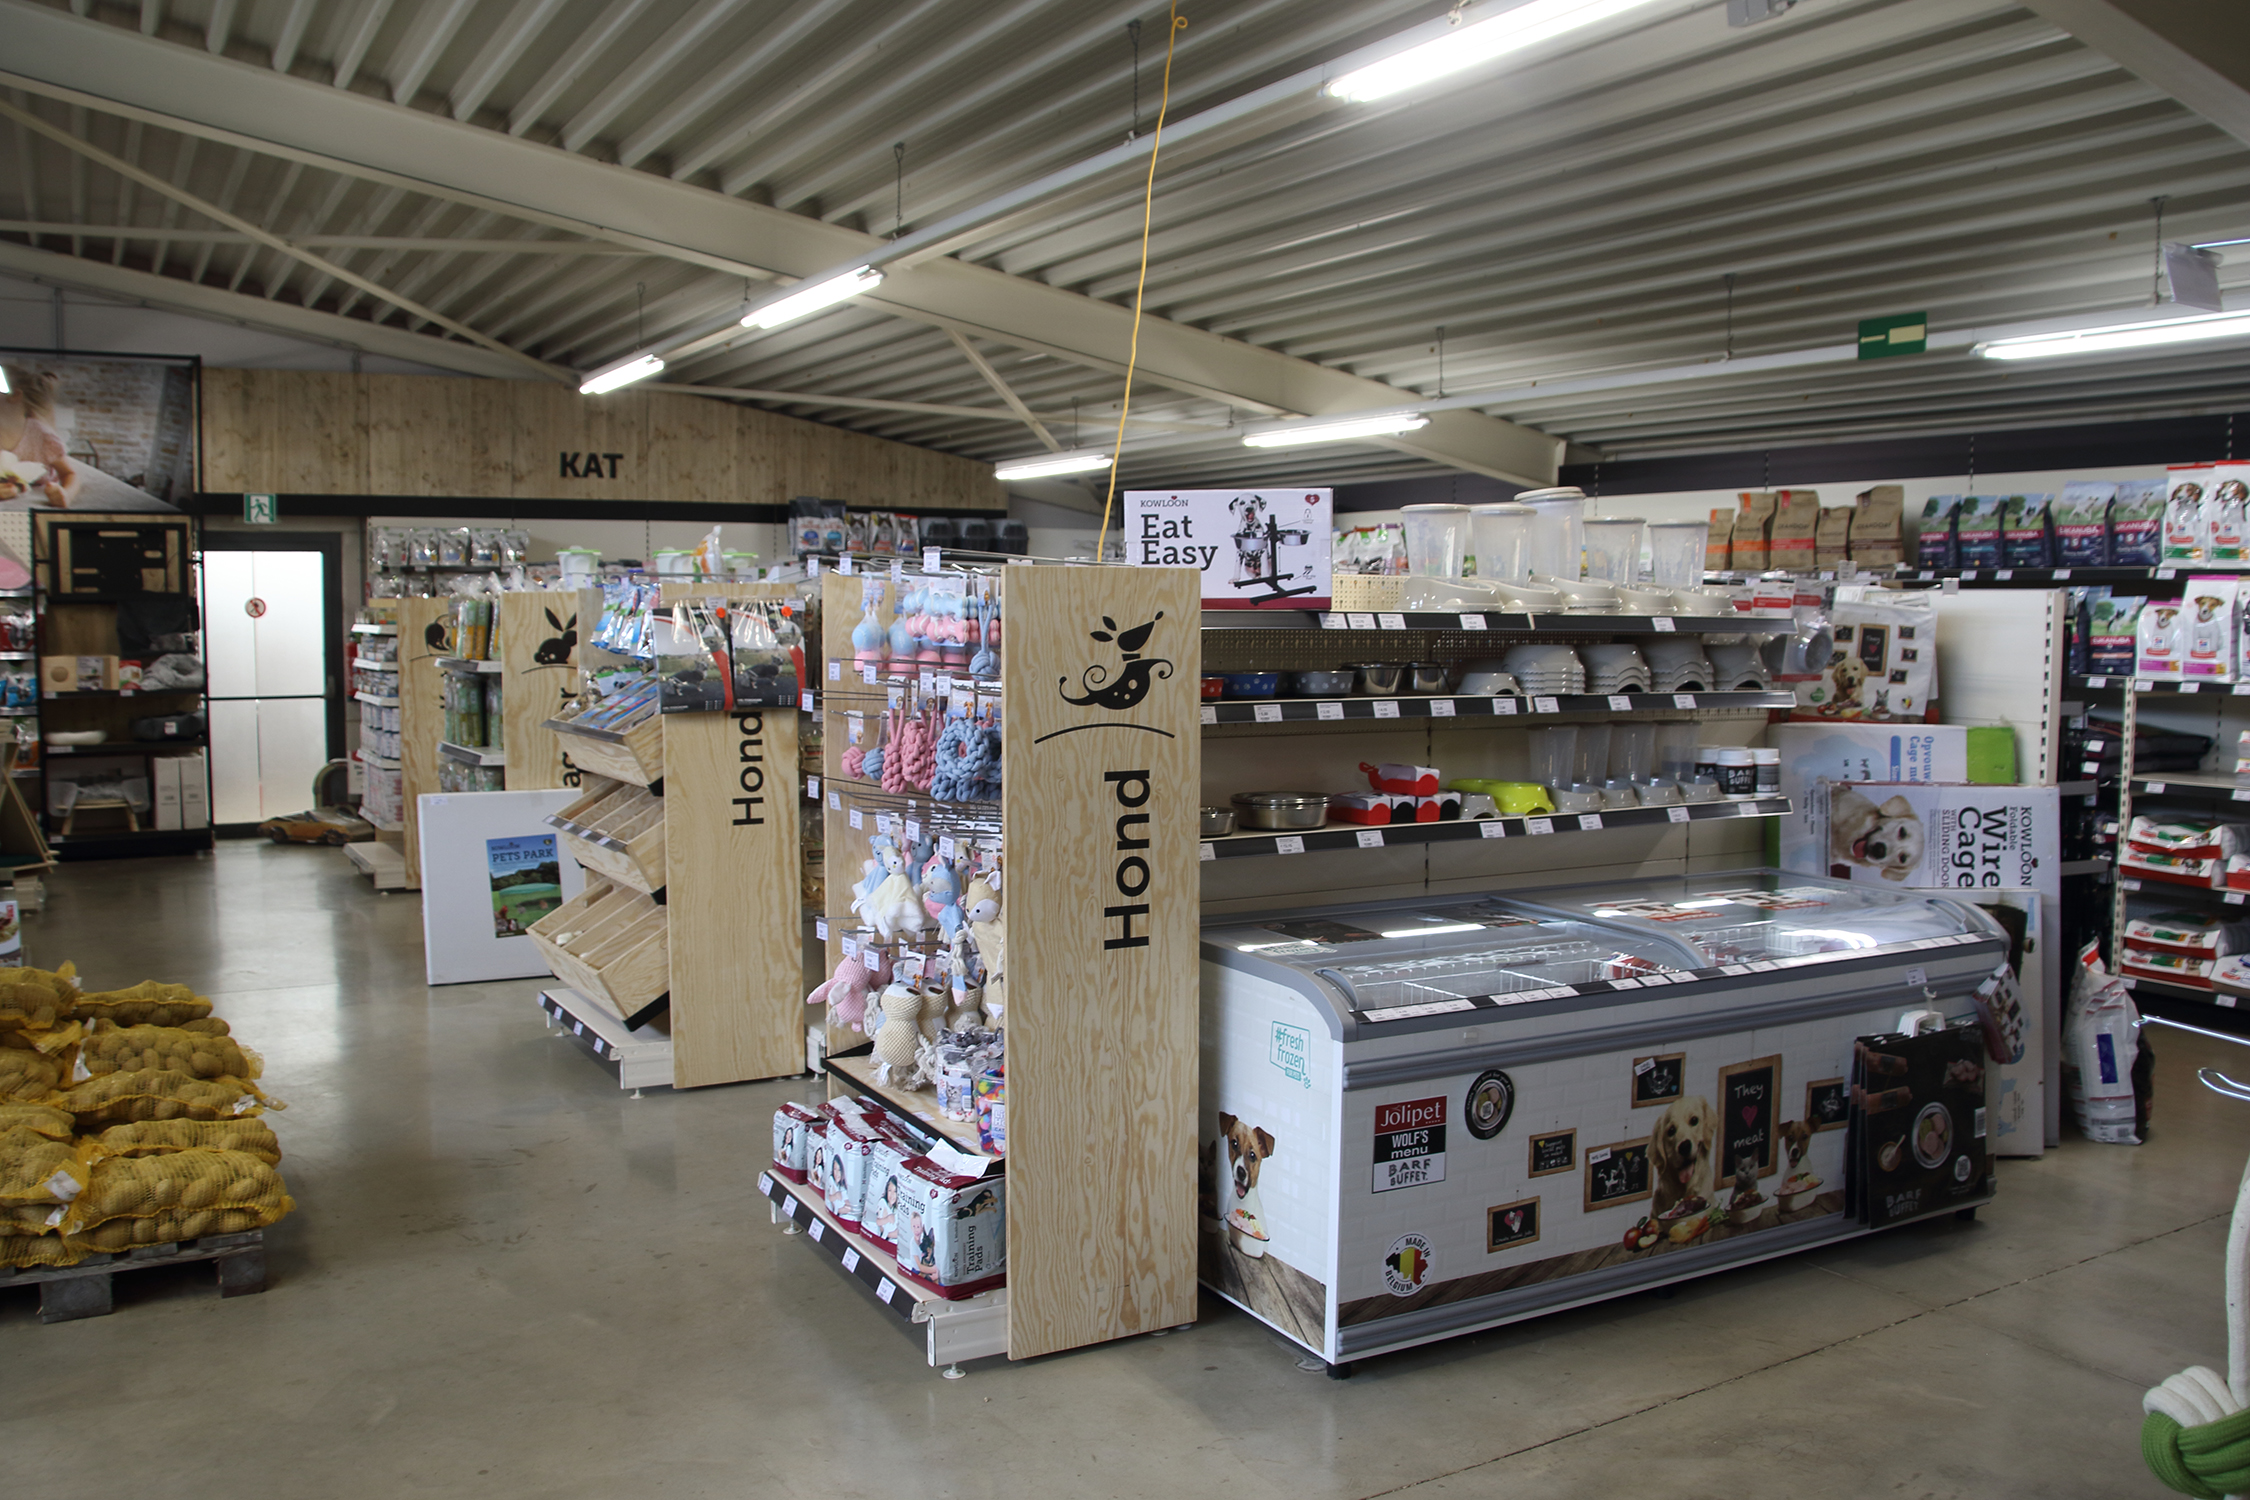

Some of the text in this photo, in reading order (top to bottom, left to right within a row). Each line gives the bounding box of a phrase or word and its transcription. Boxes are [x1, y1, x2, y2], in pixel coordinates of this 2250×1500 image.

[559, 452, 624, 479] KAT
[1140, 498, 1189, 508] KOWLOON
[1141, 513, 1193, 540] Eat
[1141, 540, 1218, 571] Easy
[1907, 736, 1921, 764] Cage
[731, 712, 764, 826] Hond
[1941, 809, 1950, 854] SLIDING
[2009, 806, 2019, 851] Foldable
[492, 848, 554, 863] PETS PARK
[1951, 806, 1982, 888] Cage
[1981, 805, 2009, 888] Wire
[2020, 805, 2035, 887] KOWLOON
[1104, 769, 1151, 951] Hond
[1275, 1026, 1304, 1052] #fresh
[1277, 1043, 1306, 1076] frozen
[1734, 1083, 1764, 1101] They
[1391, 1145, 1428, 1159] menu
[1392, 1130, 1429, 1148] WOLF'S
[1733, 1131, 1764, 1150] meat
[1388, 1158, 1431, 1178] BARF
[1886, 1188, 1922, 1209] BARF
[966, 1225, 976, 1275] Training
[974, 1245, 984, 1272] Pads
[1405, 1237, 1432, 1258] MADE IN
[1385, 1269, 1413, 1292] BELGIUM
